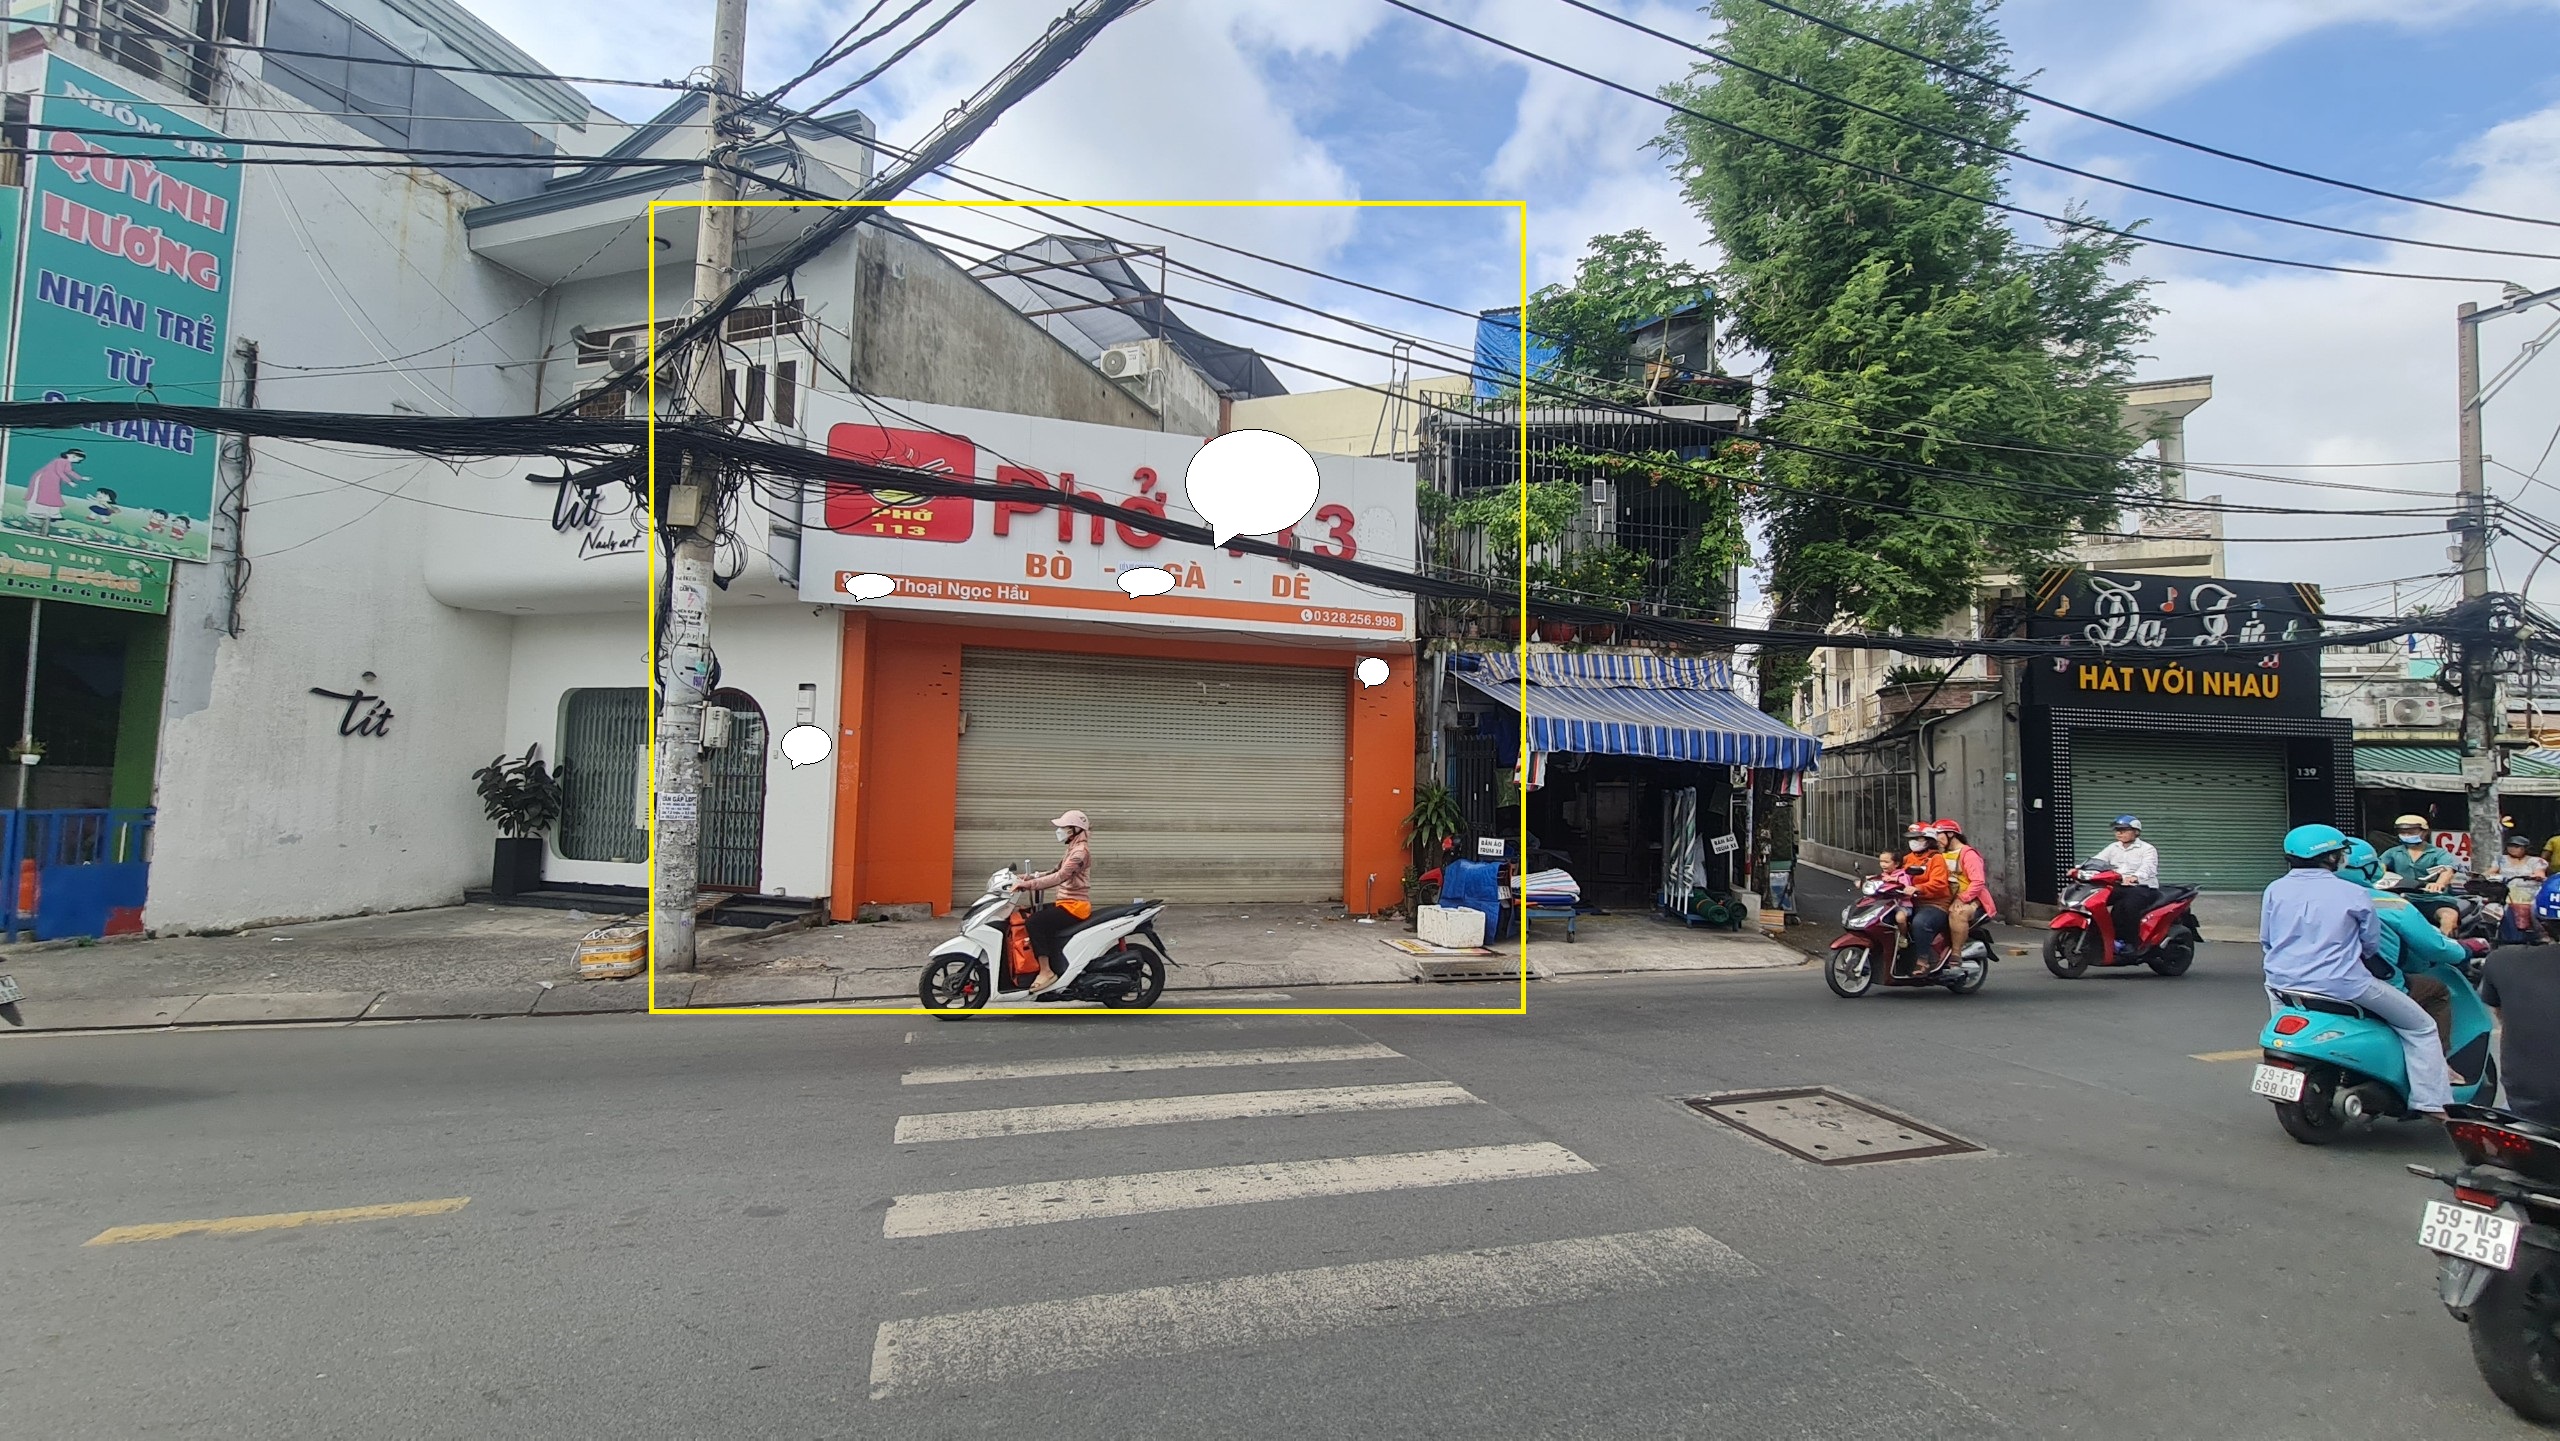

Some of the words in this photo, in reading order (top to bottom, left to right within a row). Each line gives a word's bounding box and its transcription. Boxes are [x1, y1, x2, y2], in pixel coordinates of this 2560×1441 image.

[65, 80, 163, 134] NHÓM
[48, 130, 228, 234] QUỲNH
[41, 190, 221, 292] HƯƠNG
[37, 268, 147, 332] NHẬN
[155, 314, 216, 354] TRẺ
[104, 346, 155, 386] TỪ
[872, 507, 933, 521] PHỞ
[994, 465, 1167, 548] Phở
[872, 523, 926, 535] 113
[893, 578, 942, 597] Thoại
[948, 582, 992, 600] Ngọc
[997, 584, 1029, 601] Hầu
[1026, 550, 1072, 579] BÒ
[1272, 573, 1311, 600] DÊ
[1314, 610, 1397, 628] 0328.256.998
[2079, 660, 2134, 691] HÁT
[2142, 661, 2194, 694] VỚI
[2203, 671, 2280, 699] NHAU
[2296, 767, 2317, 776] 139
[2255, 1079, 2296, 1098] 698.09
[2436, 1206, 2502, 1239] 59-N3
[2423, 1225, 2506, 1264] 302.58
